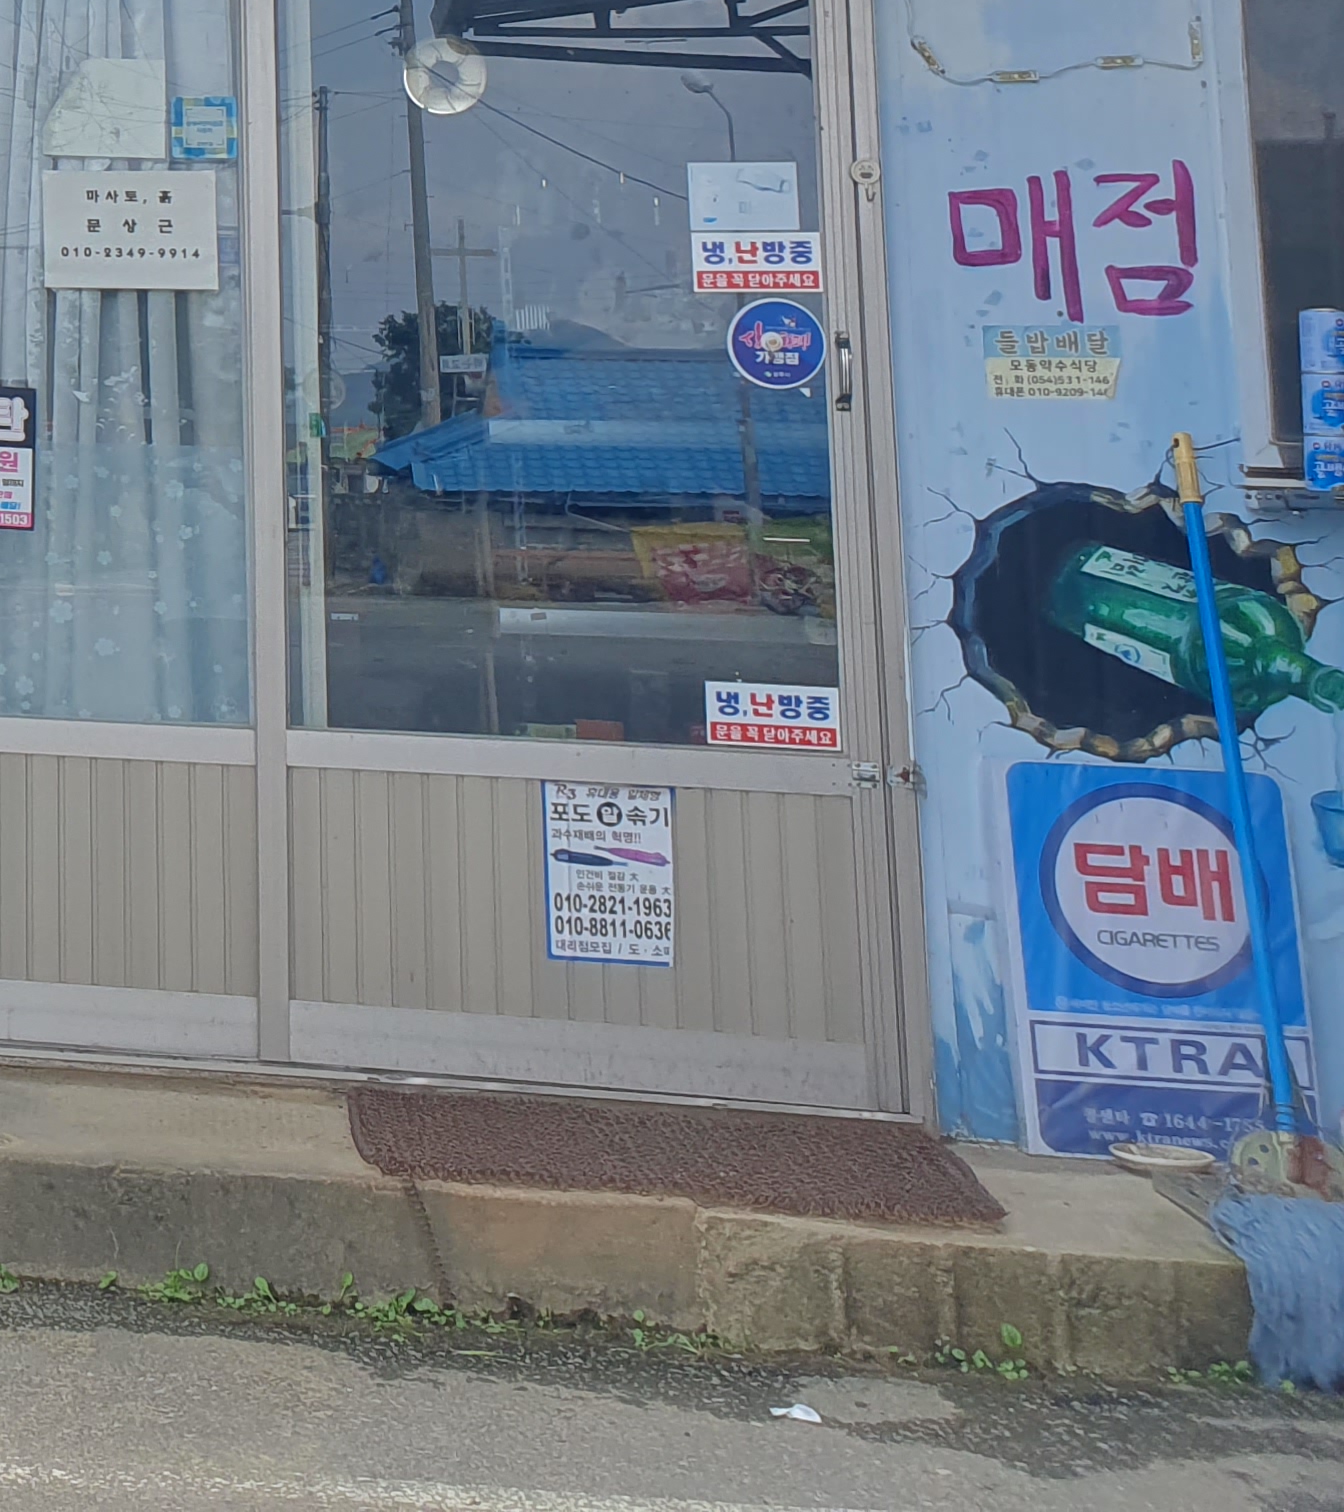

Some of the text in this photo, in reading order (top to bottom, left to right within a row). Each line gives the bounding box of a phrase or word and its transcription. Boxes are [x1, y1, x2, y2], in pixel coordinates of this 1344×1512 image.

[157, 190, 173, 205] 흙
[947, 159, 1199, 323] 매점
[60, 246, 201, 259] 010-2349-9914
[701, 240, 813, 266] 냉,난방중
[701, 273, 816, 288] 문을 꼭 닫아주세요
[994, 330, 1110, 356] 들밥배달
[1009, 359, 1098, 373] 모동약수식당
[994, 386, 1025, 398] 휴대폰
[715, 690, 831, 722] 냉,난방중
[715, 723, 833, 745] 문을 꼭 닫아주세요
[551, 828, 607, 843] 과수재배의
[575, 869, 604, 881] 인건비
[1073, 842, 1236, 923] 담배
[554, 892, 672, 918] 010-2821-1963
[555, 938, 612, 954] 대리점모집
[1096, 929, 1221, 953] CIGARETTES
[1075, 1032, 1263, 1079] KTRA
